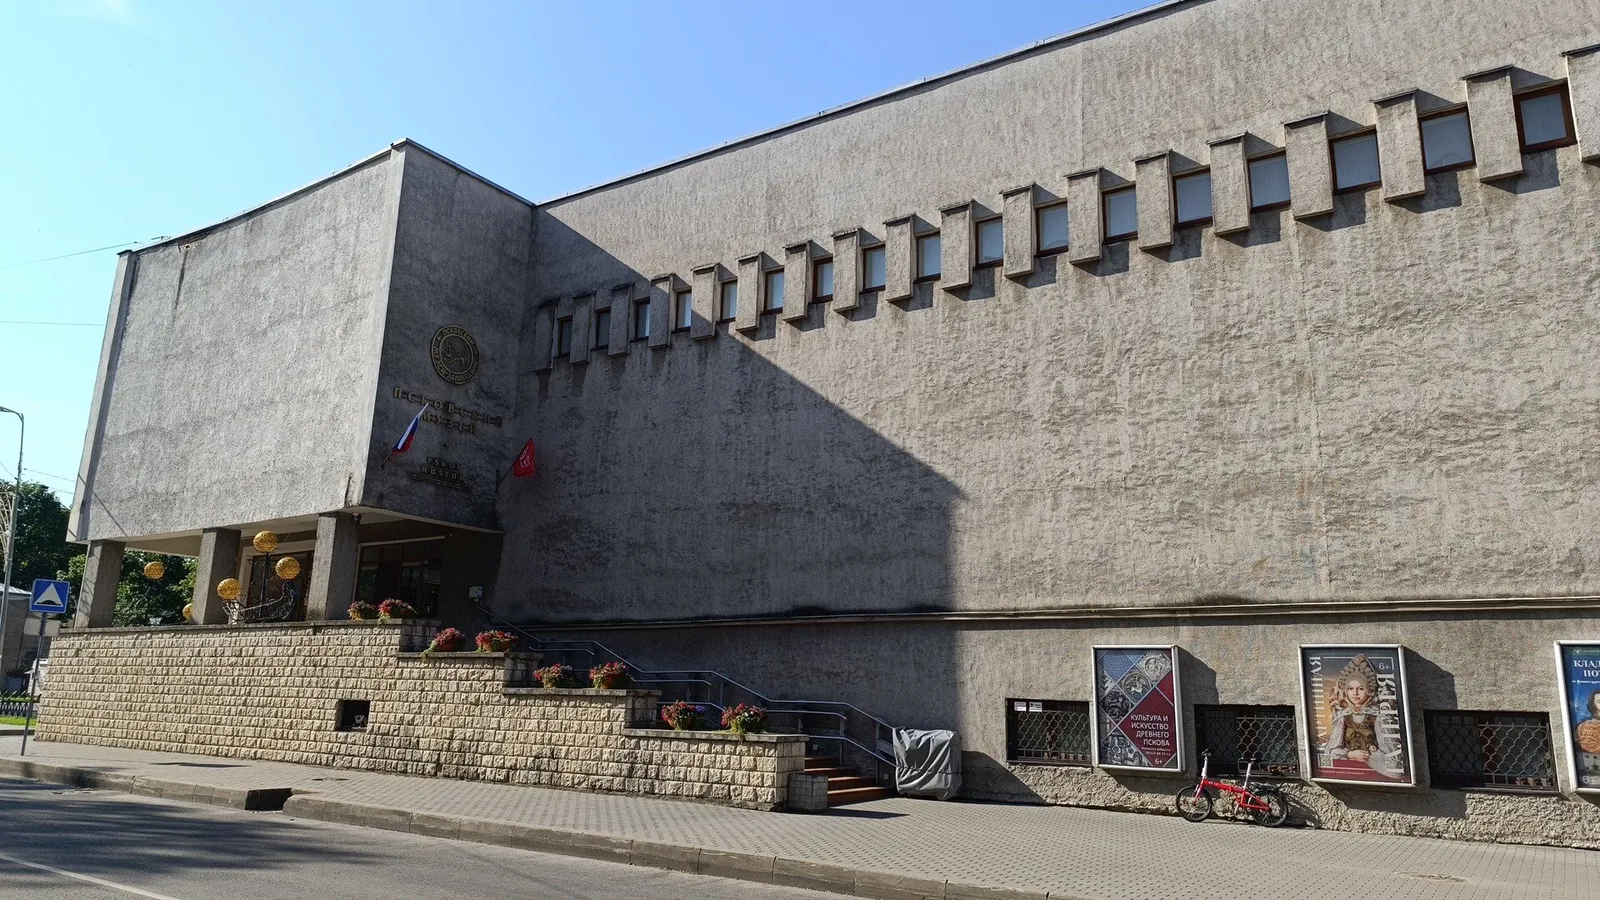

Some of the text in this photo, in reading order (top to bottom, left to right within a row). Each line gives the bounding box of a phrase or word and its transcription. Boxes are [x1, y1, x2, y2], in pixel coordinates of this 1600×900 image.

[394, 387, 502, 428] ПСКОВСКИЙ
[421, 411, 477, 436] МУЗЕЙ
[427, 457, 461, 470] PSKOV
[420, 466, 466, 481] MUSEUM
[1379, 662, 1390, 670] 6+
[1131, 722, 1169, 730] ИСКУССТВО
[1376, 673, 1405, 774] ГАЛЕРЕЯ
[1136, 730, 1170, 738] ДРЕВНЕГО
[1154, 757, 1163, 765] 6+
